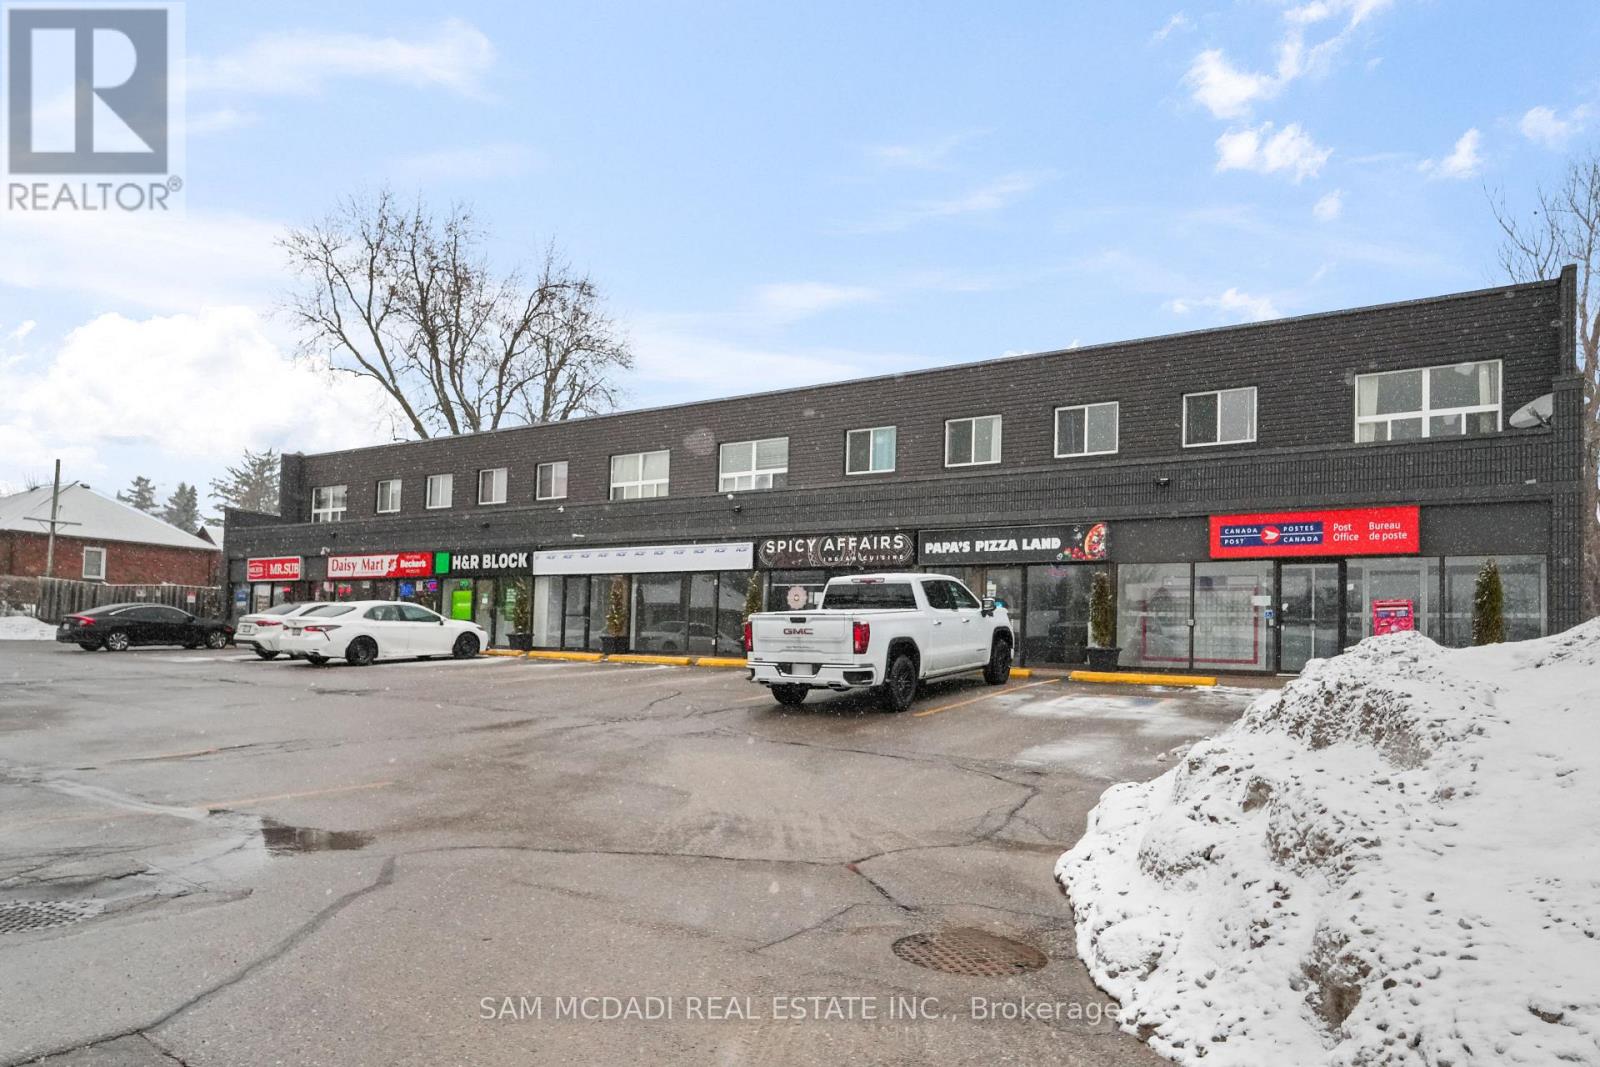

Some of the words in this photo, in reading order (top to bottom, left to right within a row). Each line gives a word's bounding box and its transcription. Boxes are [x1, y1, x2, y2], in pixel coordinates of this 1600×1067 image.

[1333, 523, 1352, 531] Post
[1368, 521, 1401, 530] Bureau
[1283, 535, 1319, 543] CANADA
[1333, 532, 1360, 541] Office
[1369, 531, 1380, 540] de
[1382, 532, 1408, 541] poste
[766, 538, 816, 553] SPICY
[823, 535, 904, 551] AFFAIRS
[924, 540, 971, 554] PAPA'S
[975, 539, 1018, 552] PIZZA
[1022, 537, 1062, 550] LAND
[452, 554, 480, 570] H&R
[482, 552, 528, 568] BLOCK
[331, 558, 358, 576] Daisy
[362, 558, 384, 571] Mart
